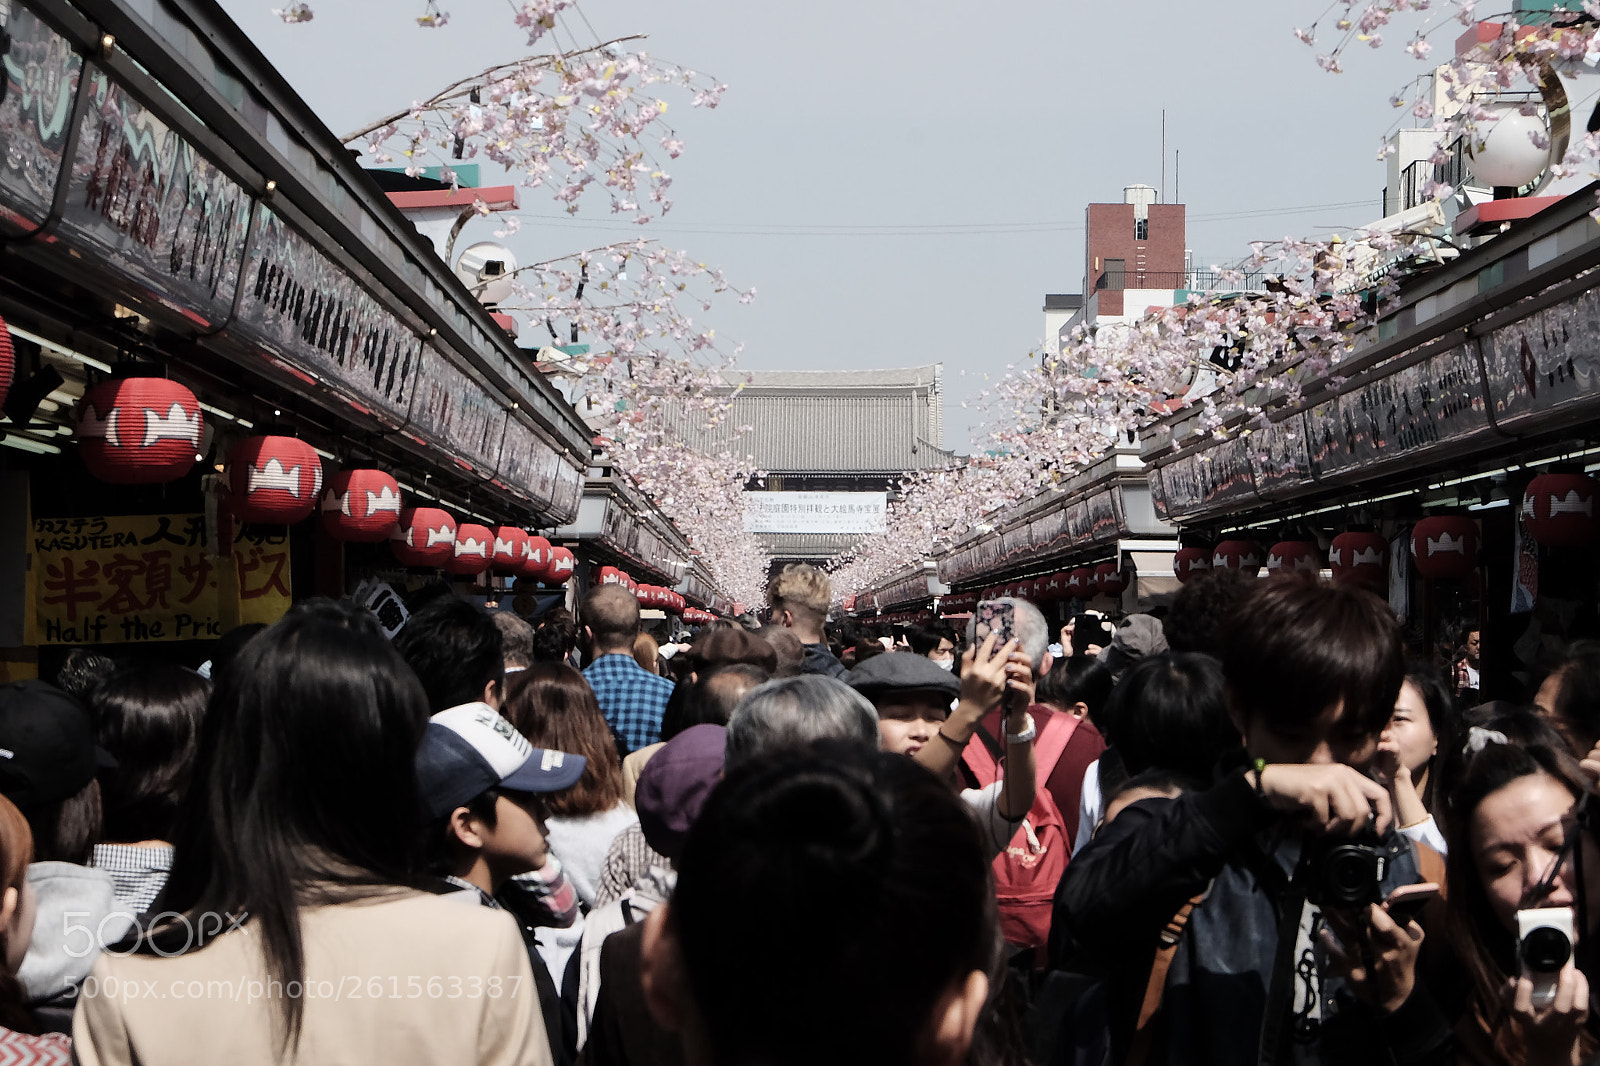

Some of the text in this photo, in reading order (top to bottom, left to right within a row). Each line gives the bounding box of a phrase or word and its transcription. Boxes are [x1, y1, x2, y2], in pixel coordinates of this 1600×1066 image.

[757, 503, 880, 514] 院庭園特別拝観と大絵馬寺宝展
[36, 517, 108, 535] カステラ
[35, 532, 138, 553] KASUTERA
[43, 548, 290, 622] 半額サビス
[46, 613, 222, 643] Half the Pric
